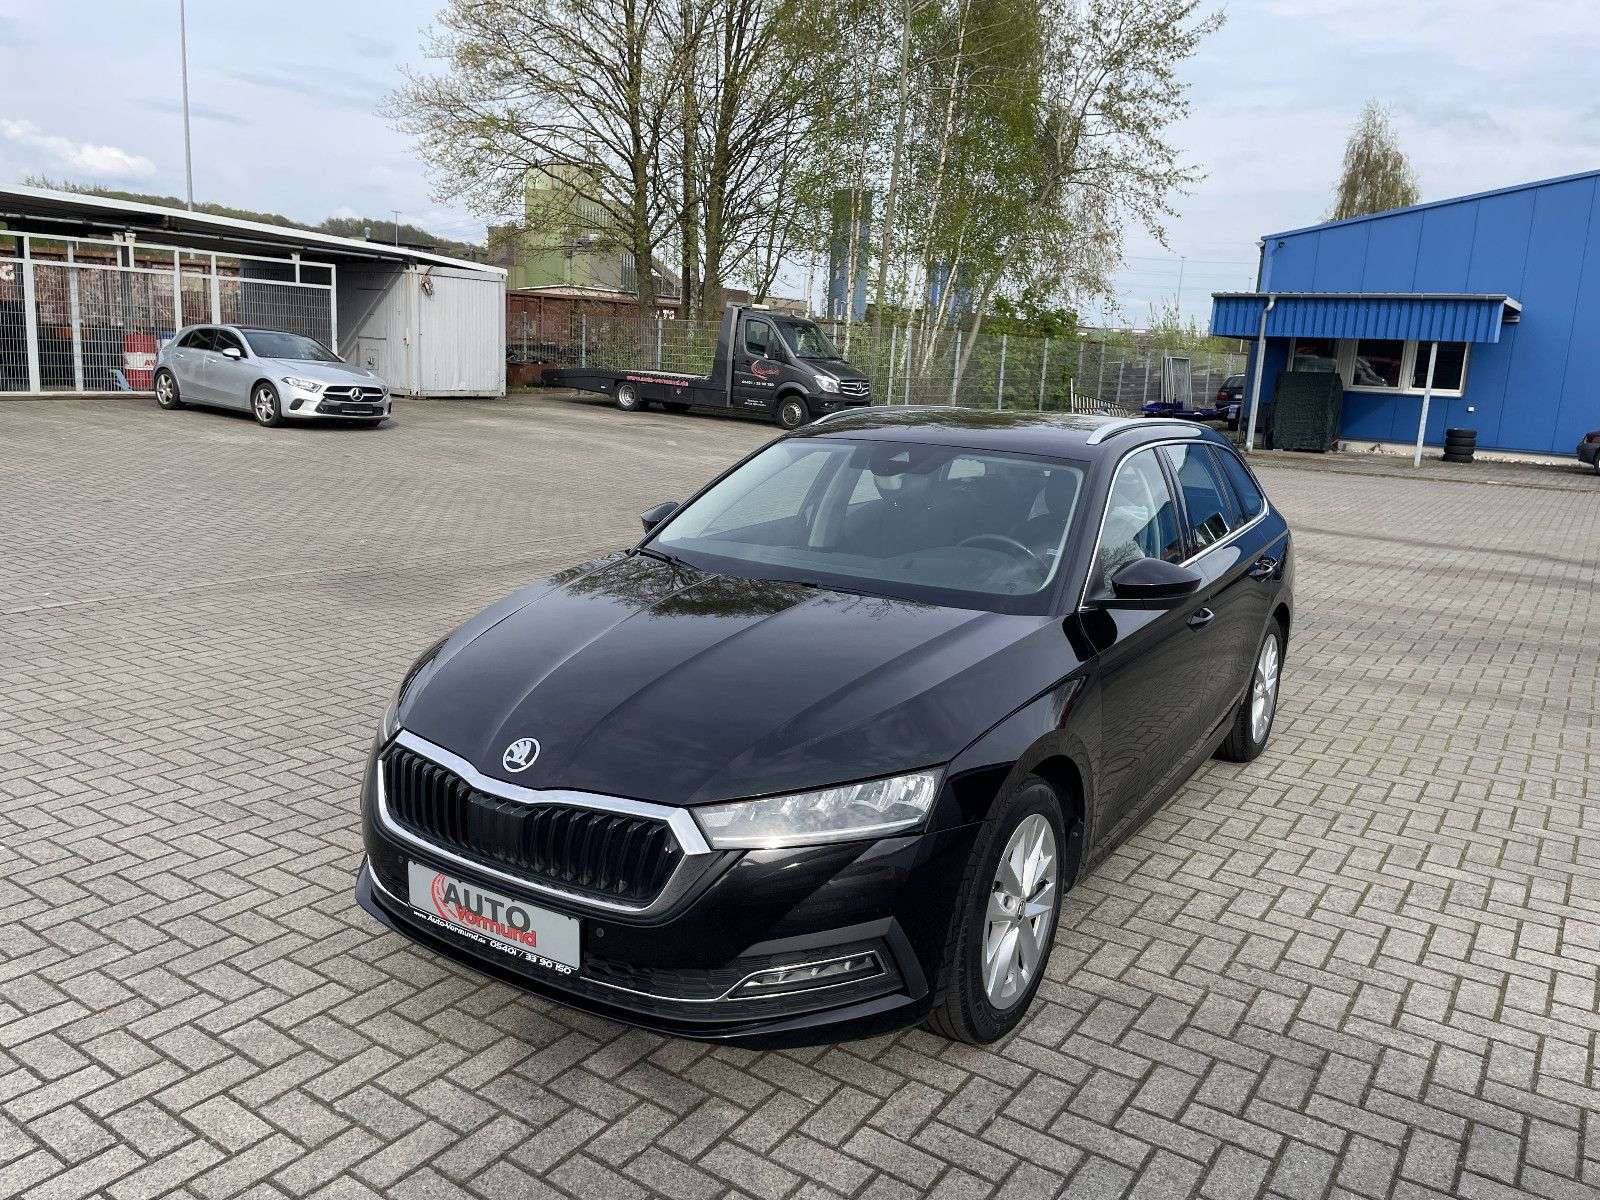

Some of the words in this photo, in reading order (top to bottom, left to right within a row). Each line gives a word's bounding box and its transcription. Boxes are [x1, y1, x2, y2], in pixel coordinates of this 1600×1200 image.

[443, 882, 531, 933] AUTO
[454, 900, 537, 948] Vormund
[525, 952, 537, 963] 33
